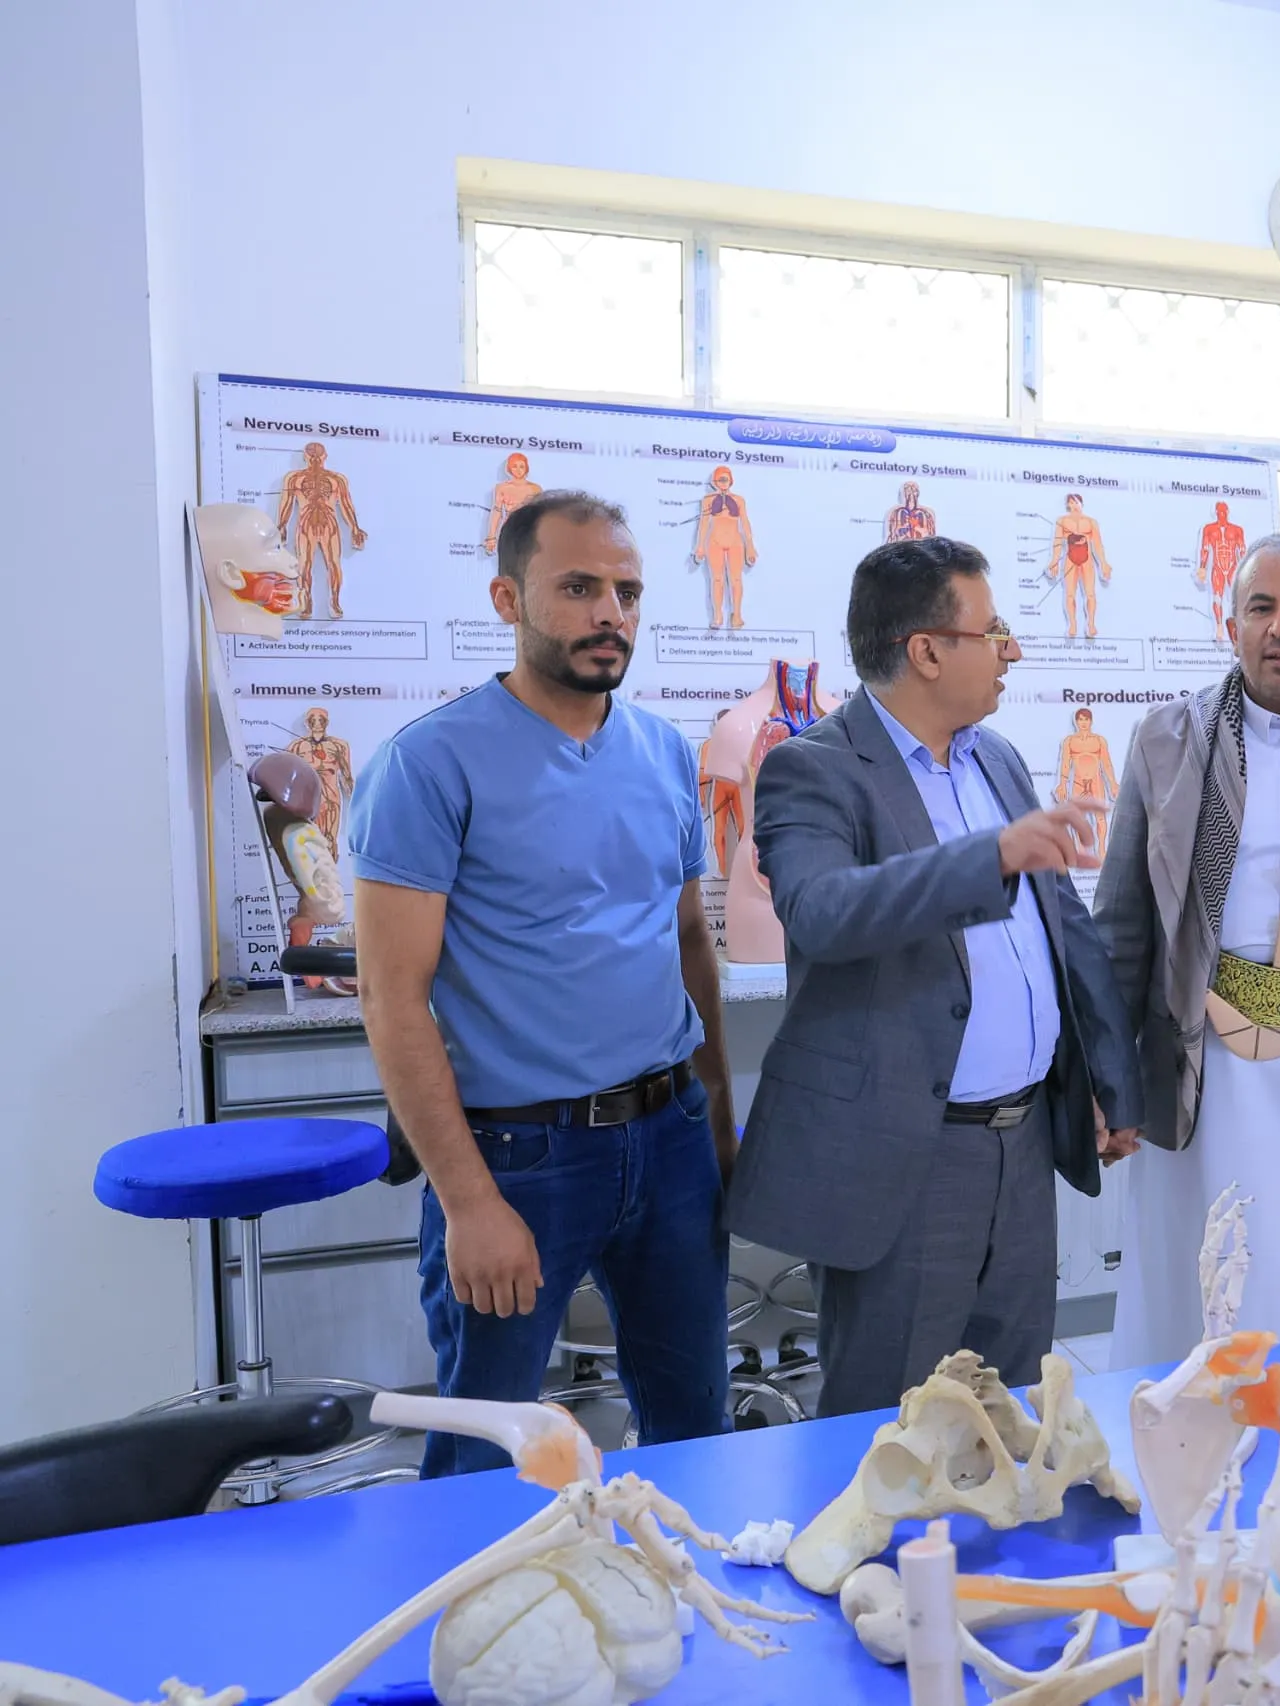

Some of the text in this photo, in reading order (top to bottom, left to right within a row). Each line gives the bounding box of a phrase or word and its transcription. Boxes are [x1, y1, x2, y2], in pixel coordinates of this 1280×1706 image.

[244, 416, 380, 437] Nervous System
[452, 431, 583, 450] Excretory System
[652, 444, 785, 463] Respiratory System
[850, 459, 967, 476] Circulatory System
[1023, 470, 1119, 487] Digestive System
[237, 489, 262, 497] Spinal
[1171, 481, 1261, 497] Muscular System
[454, 619, 490, 627] Function
[656, 624, 689, 632] Function
[284, 628, 417, 638] and processes sensory information
[248, 641, 353, 651] Activates body responses
[781, 637, 798, 645] body
[668, 647, 698, 655] Delivers
[699, 649, 723, 657] oxygen
[251, 683, 381, 698] Immune System
[661, 687, 731, 700] Endocrine
[1062, 688, 1174, 707] Reproductive
[240, 718, 269, 727] Thymus
[244, 743, 266, 751] ymph
[245, 895, 285, 903] Functn
[255, 908, 286, 916] Retus
[256, 923, 290, 931] Defeds
[250, 960, 265, 973] A.
